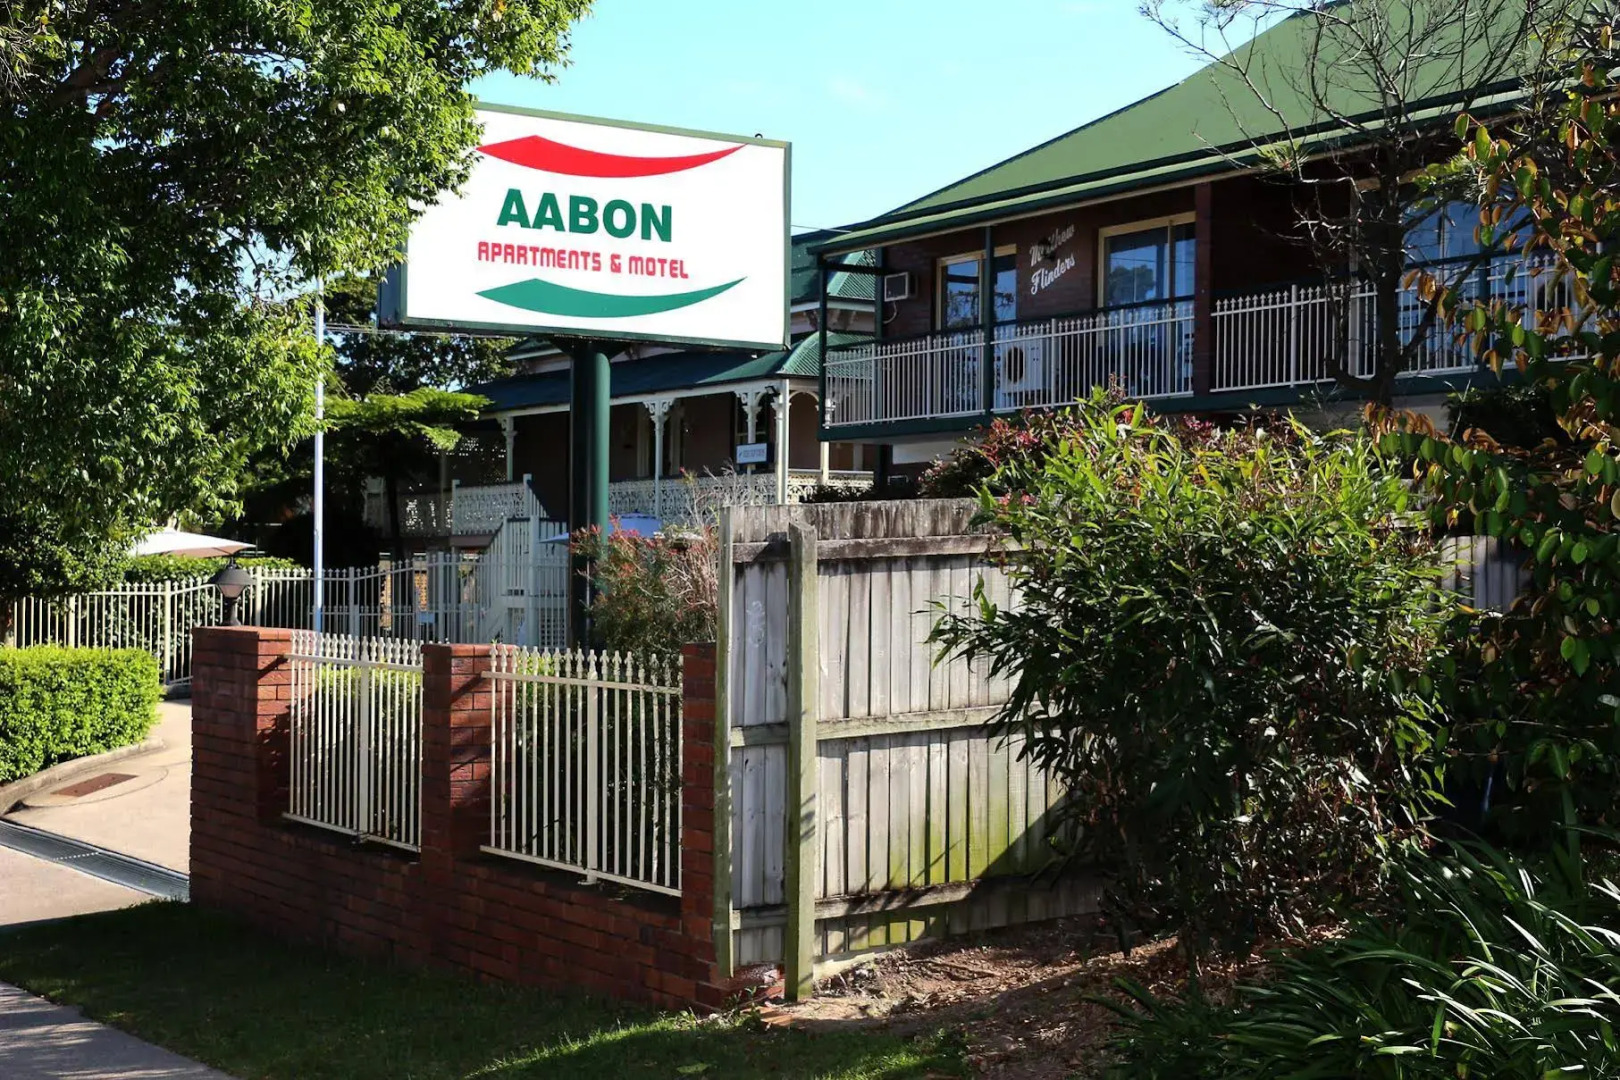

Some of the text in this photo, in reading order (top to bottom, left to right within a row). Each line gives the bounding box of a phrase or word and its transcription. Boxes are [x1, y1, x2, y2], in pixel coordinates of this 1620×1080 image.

[496, 188, 673, 242] AABON
[477, 241, 689, 279] APARTMENTS & MOTEL
[1030, 253, 1076, 295] Flinders
